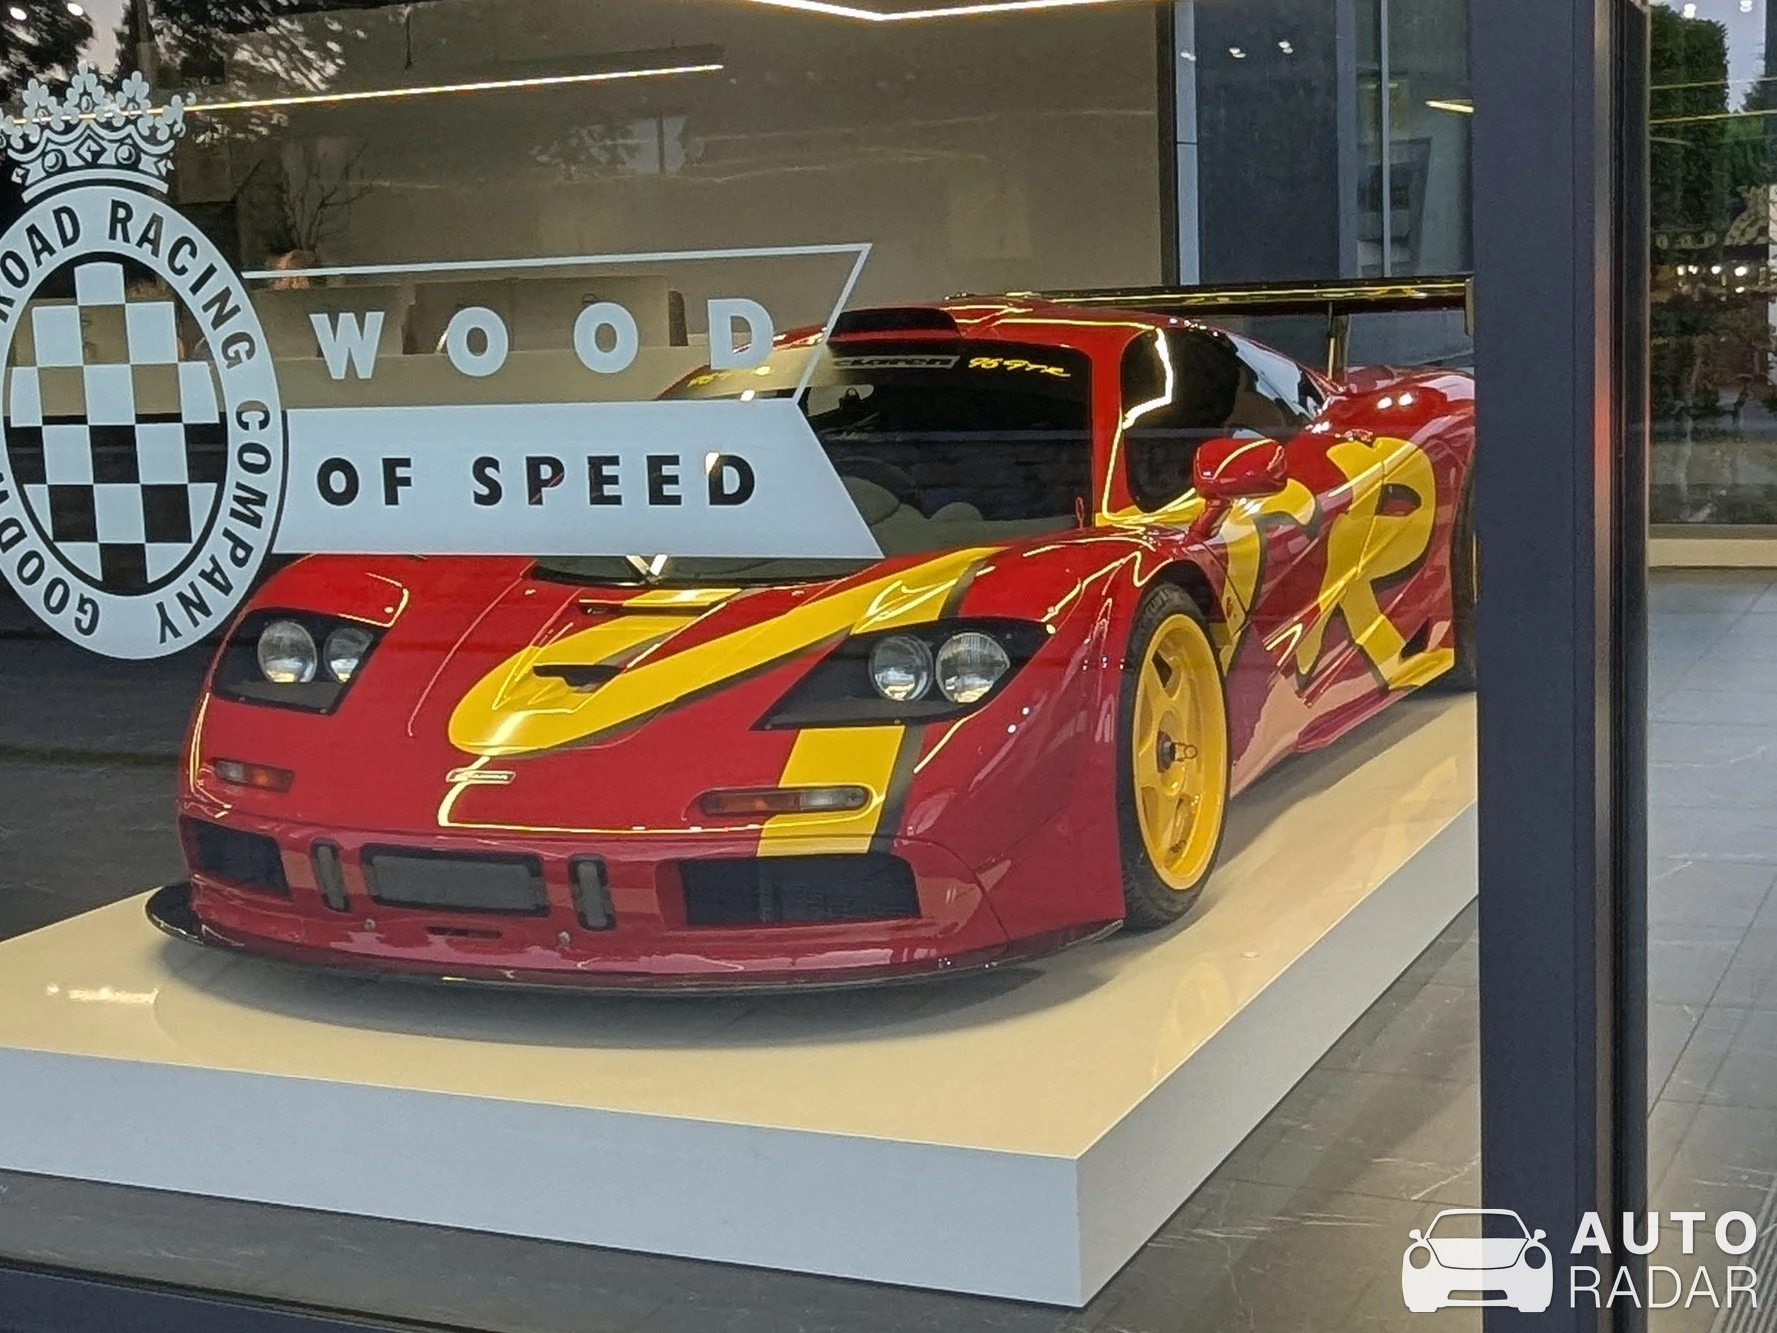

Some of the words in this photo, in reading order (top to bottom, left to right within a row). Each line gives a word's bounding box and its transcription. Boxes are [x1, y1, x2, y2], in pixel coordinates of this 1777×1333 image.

[108, 199, 256, 370] RACING
[309, 298, 775, 380] WOOD
[155, 398, 274, 645] COMPANY
[316, 456, 413, 507] OF
[472, 454, 756, 507] SPEED
